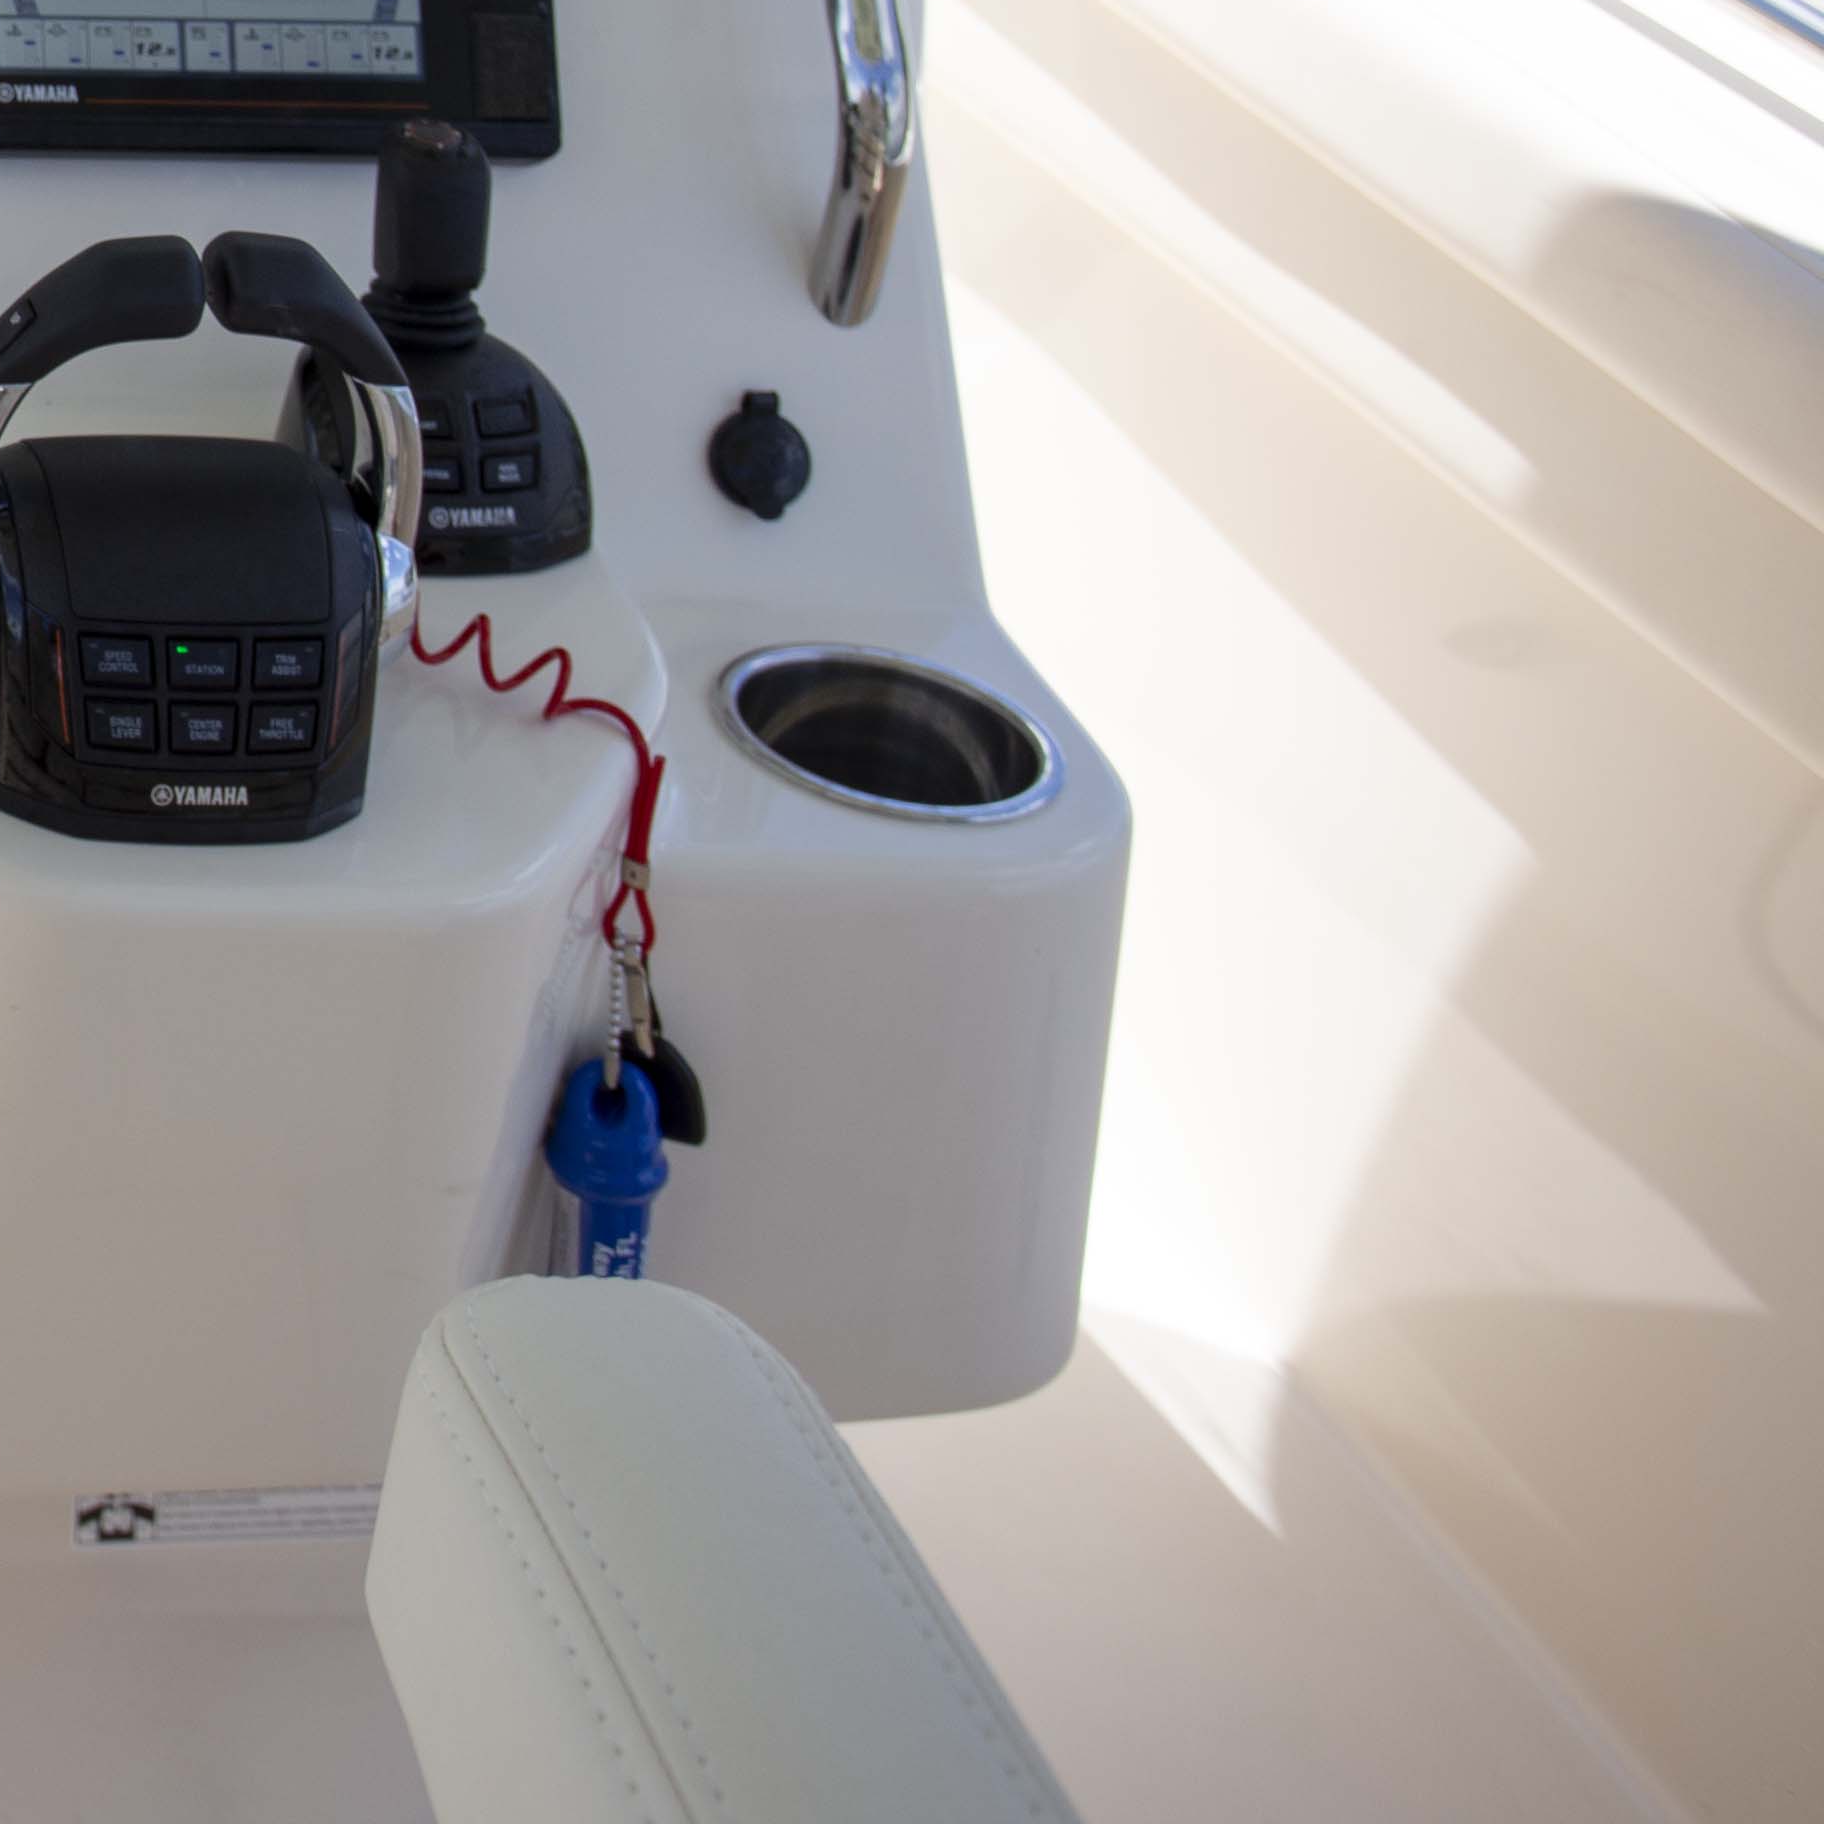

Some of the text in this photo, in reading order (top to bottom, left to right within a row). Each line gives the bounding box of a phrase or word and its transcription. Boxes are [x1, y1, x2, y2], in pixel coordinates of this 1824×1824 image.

[14, 83, 80, 104] YAMAHA
[449, 507, 517, 527] YAMAHA
[104, 650, 133, 662] SPEED
[98, 662, 139, 674] CONTROL
[184, 663, 225, 675] STATION
[110, 728, 142, 739] LEVER
[258, 729, 305, 741] THROTTLE
[174, 785, 249, 806] YAMAHA
